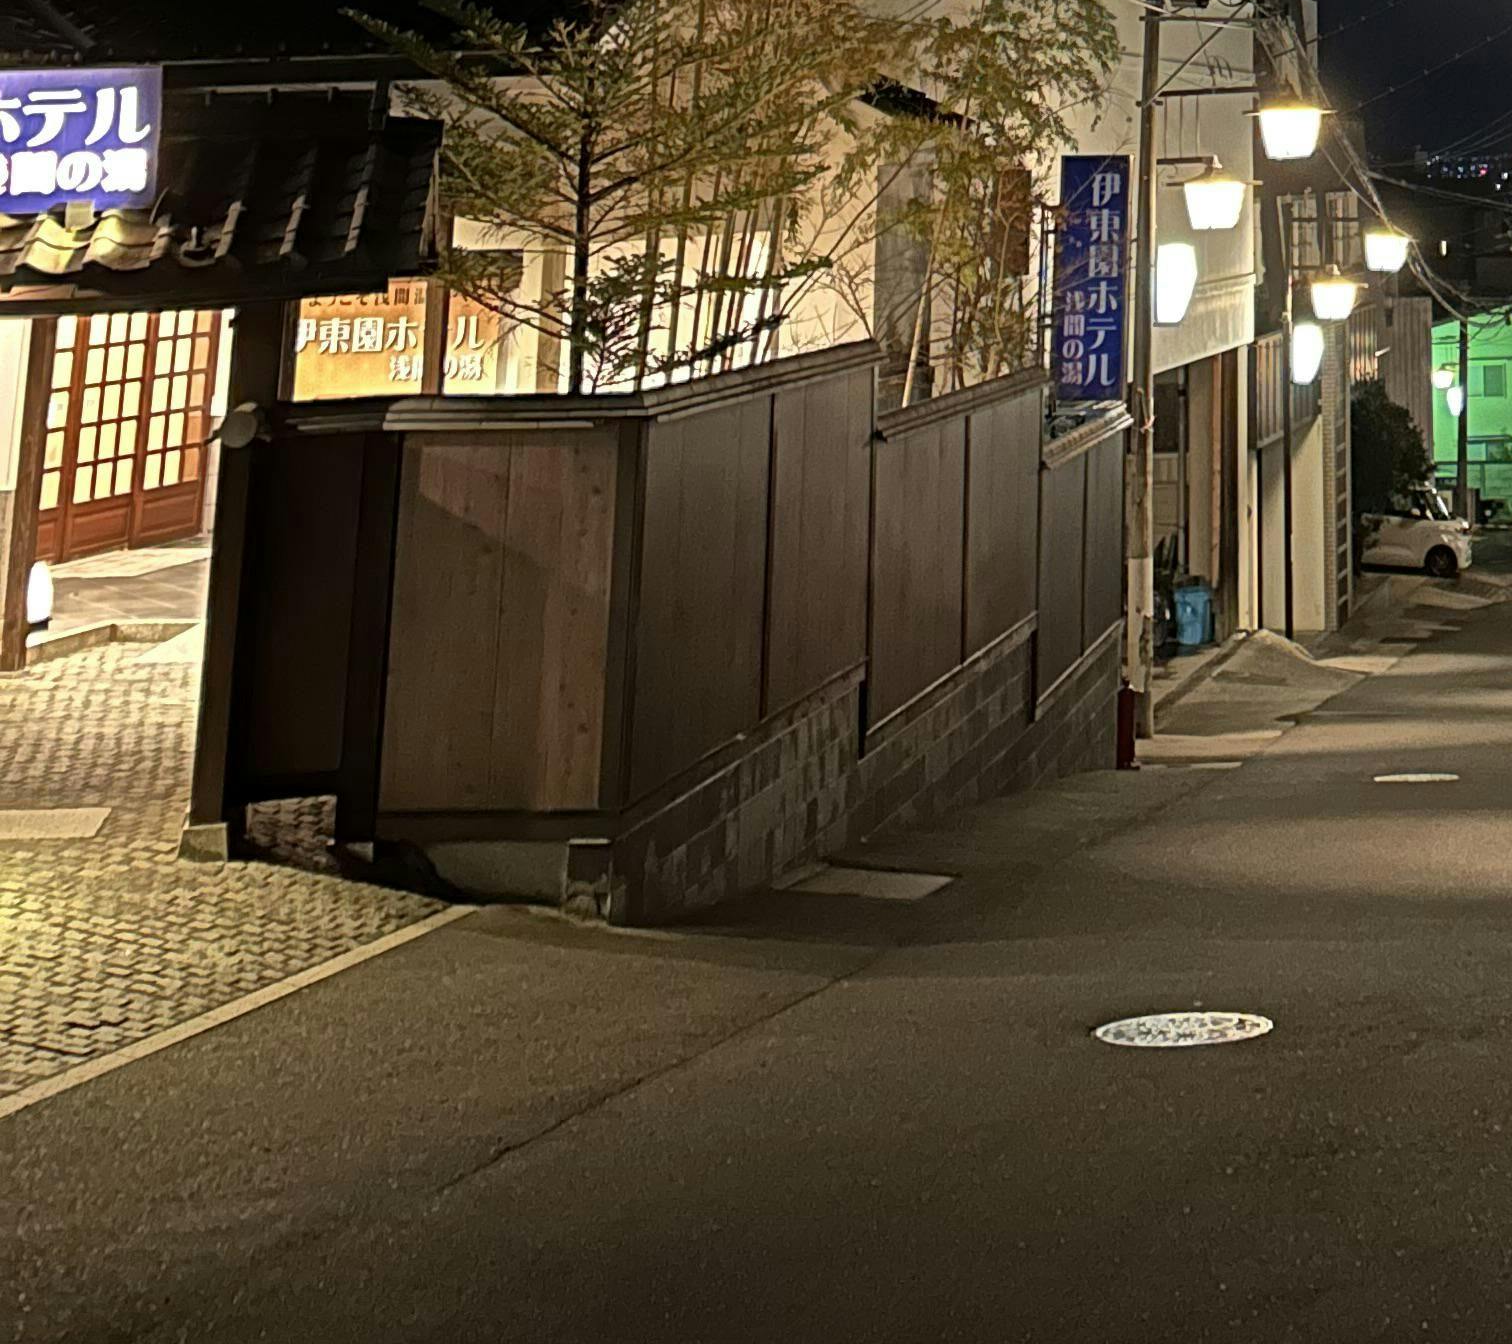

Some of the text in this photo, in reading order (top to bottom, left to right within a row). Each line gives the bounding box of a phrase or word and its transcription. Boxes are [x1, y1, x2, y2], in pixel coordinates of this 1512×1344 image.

[295, 315, 485, 355] 伊東園ホル
[1085, 173, 1121, 387] 伊東園ホテル
